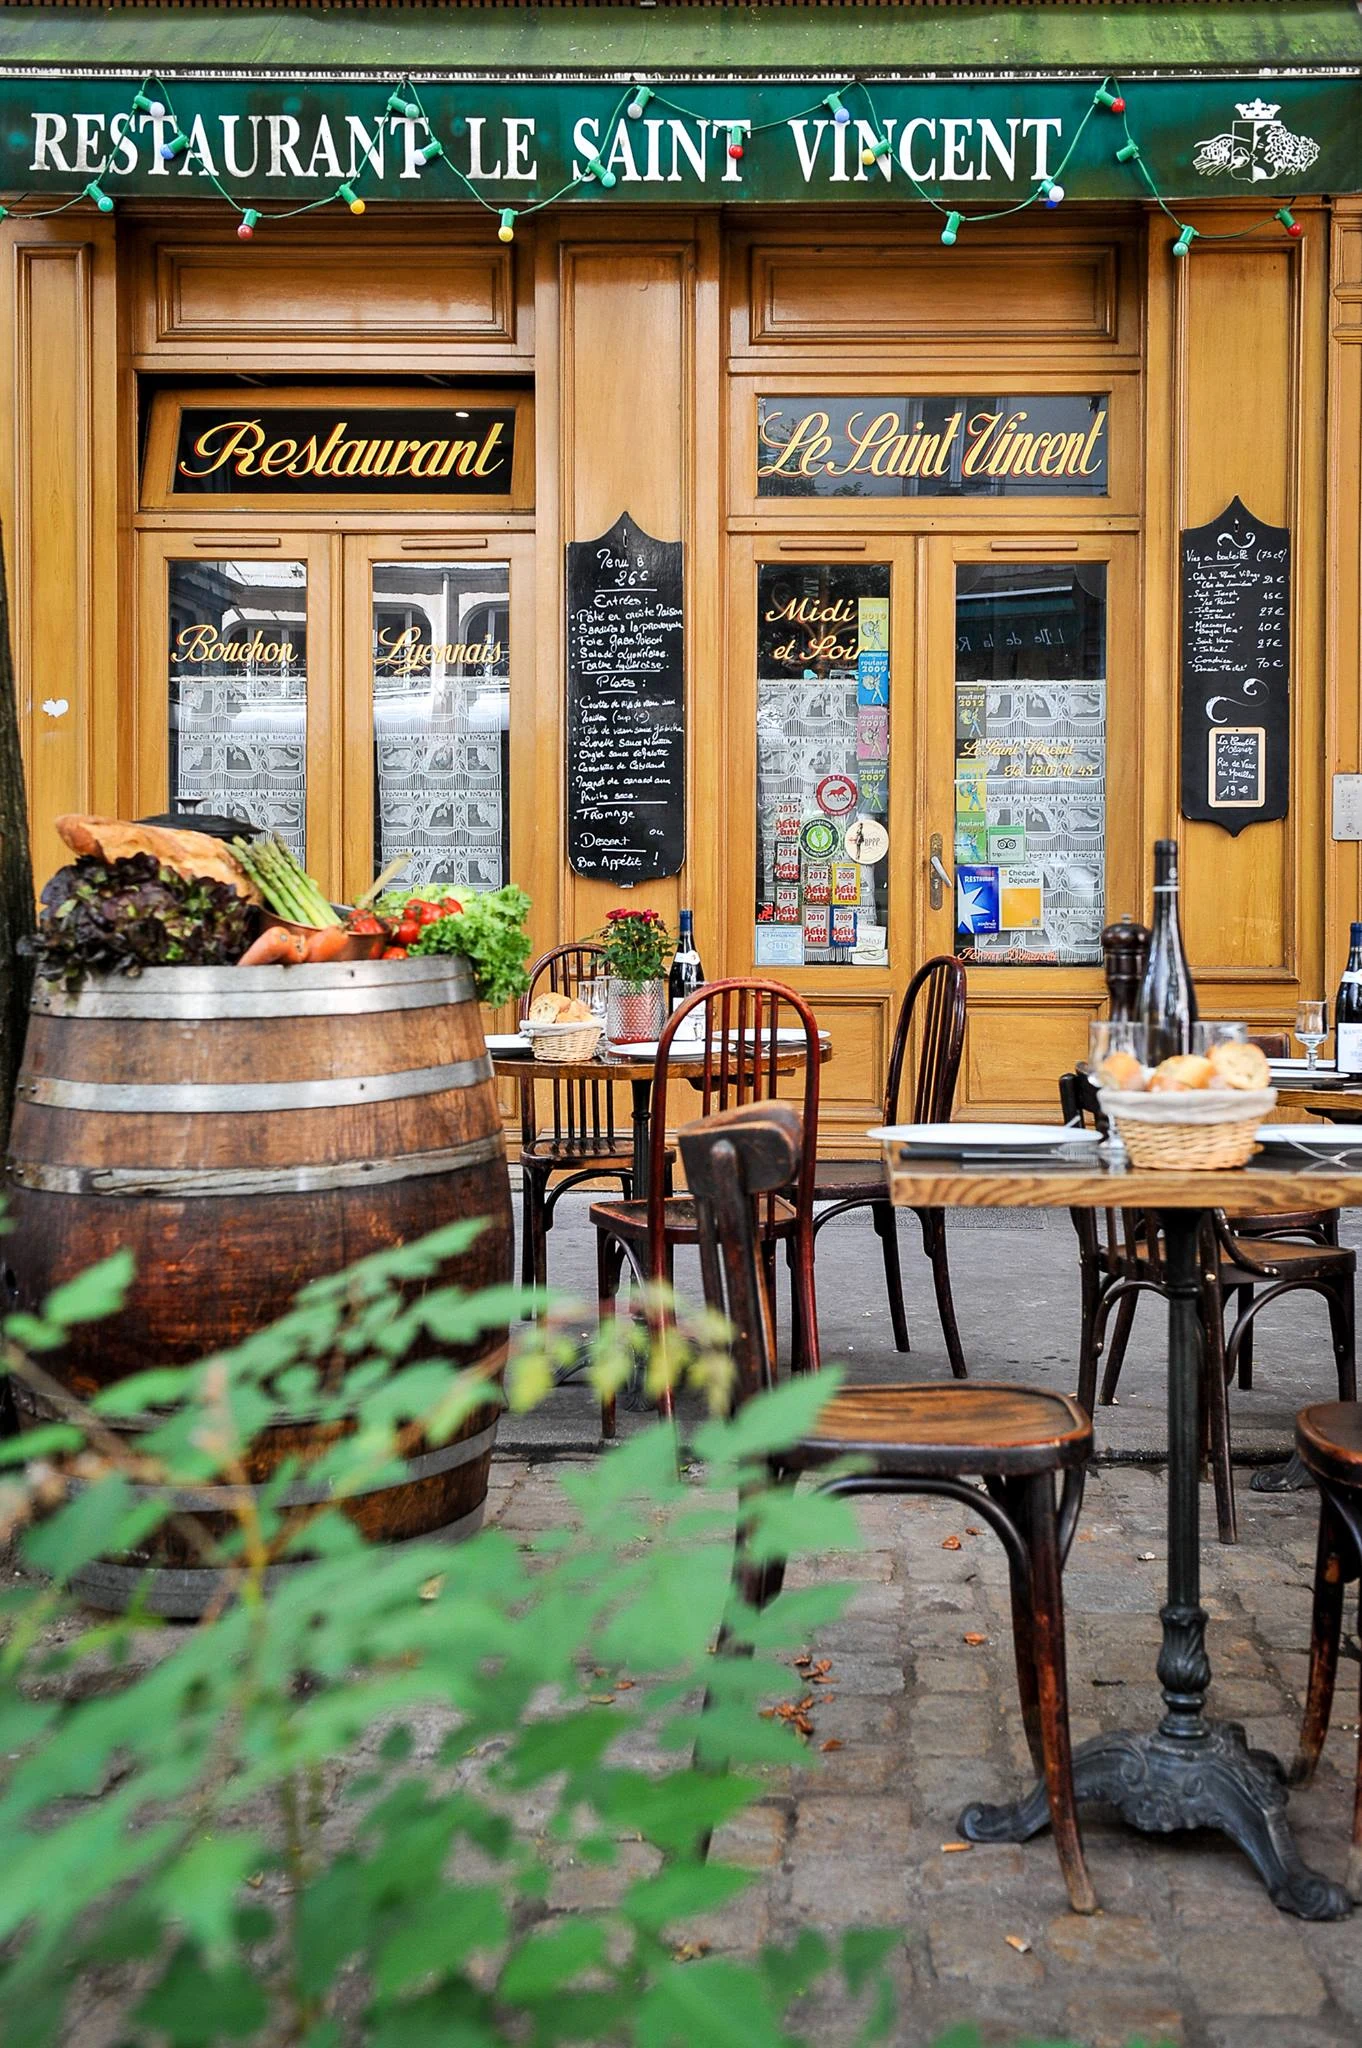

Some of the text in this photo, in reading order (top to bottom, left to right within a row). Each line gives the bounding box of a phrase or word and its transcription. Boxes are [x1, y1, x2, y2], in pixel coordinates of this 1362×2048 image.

[29, 112, 1062, 183] RESTAURANT LE SAINT VINCENT
[180, 419, 504, 478] Restaurant
[758, 411, 1106, 478] Le Saint Vincent
[766, 598, 855, 622] Midi
[608, 613, 621, 621] en
[630, 621, 639, 632] la
[577, 635, 605, 646] Foie
[171, 624, 502, 674] Bouchon Lyonnais
[580, 647, 614, 659] Salade
[773, 639, 797, 660] et
[861, 657, 887, 665] routard
[862, 665, 886, 673] 2009
[596, 675, 636, 688] Plats
[958, 692, 985, 700] routard
[981, 739, 1019, 756] Saint
[1024, 738, 1074, 756] Vincent
[617, 762, 626, 770] de
[607, 777, 619, 785] de
[778, 804, 797, 813] 2015
[649, 828, 664, 836] ou
[580, 832, 631, 848] Dessert
[778, 848, 797, 857] 2014
[577, 856, 596, 868] Bon
[601, 853, 642, 871] Appétit
[809, 871, 827, 879] 2012
[838, 871, 854, 880] 2008
[778, 891, 797, 900] 2013
[807, 913, 824, 921] 2010
[835, 912, 852, 921] 2009
